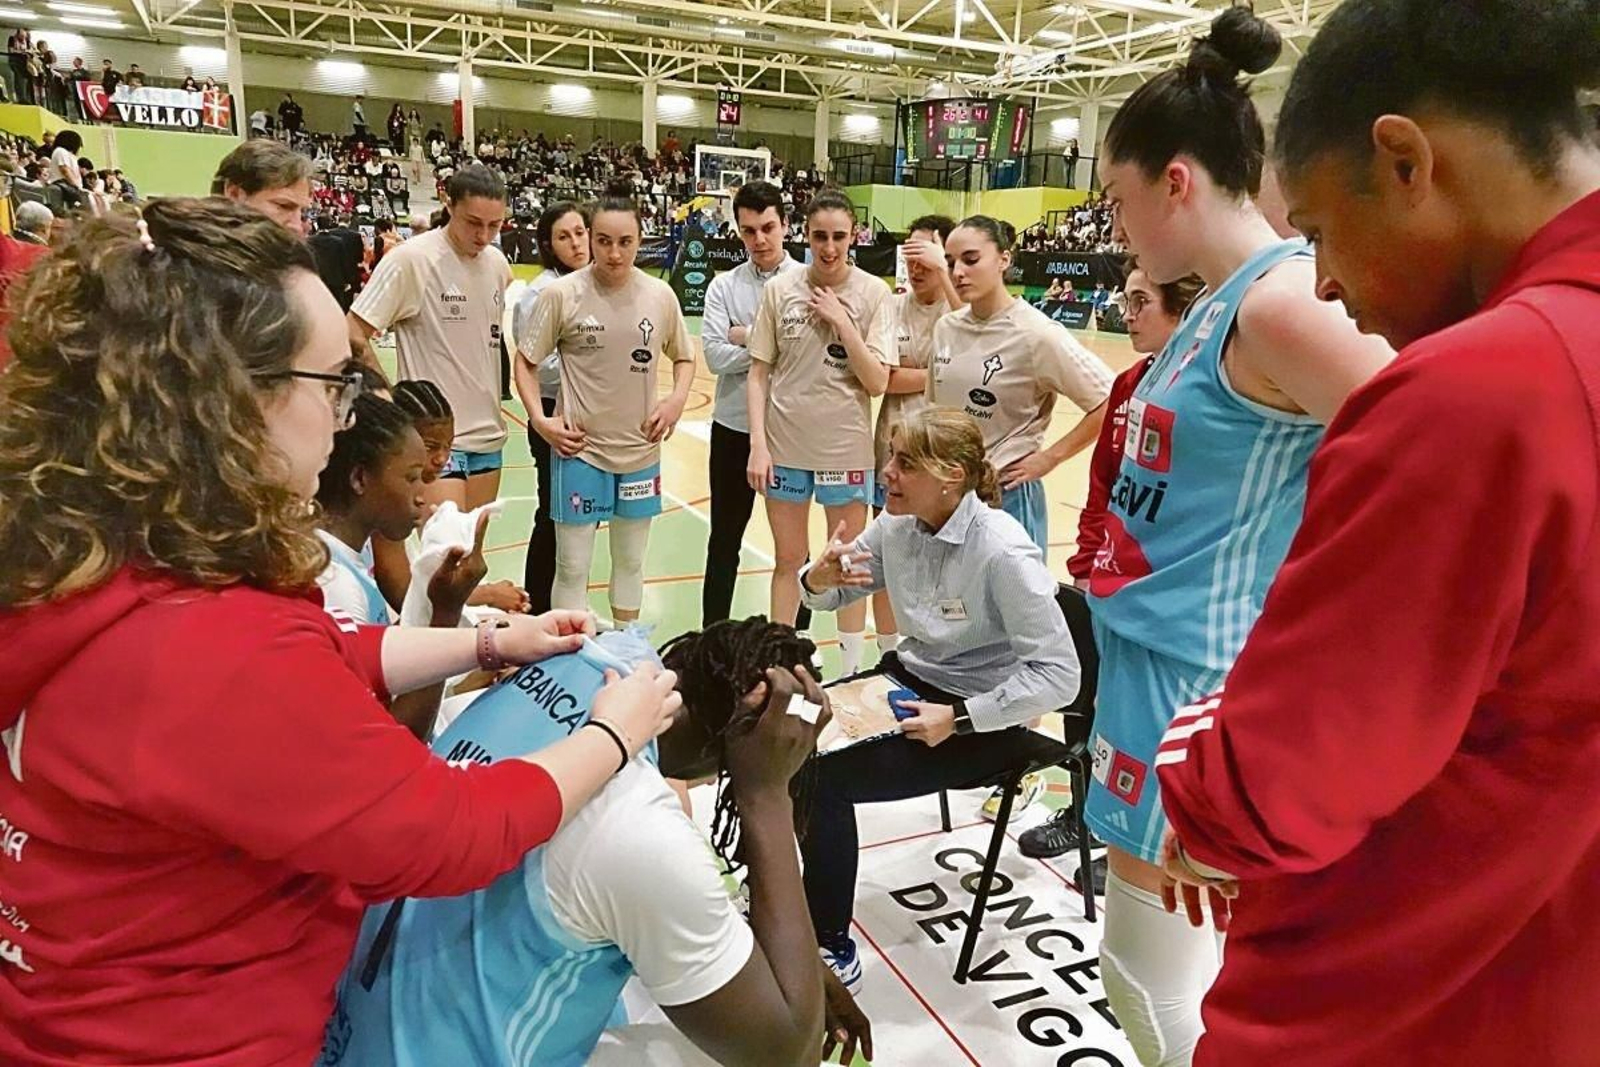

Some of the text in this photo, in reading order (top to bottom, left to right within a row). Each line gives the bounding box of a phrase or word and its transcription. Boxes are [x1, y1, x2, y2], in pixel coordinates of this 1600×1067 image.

[116, 103, 199, 128] VELLO
[1046, 262, 1089, 276] ABANCA
[889, 882, 983, 944] DE
